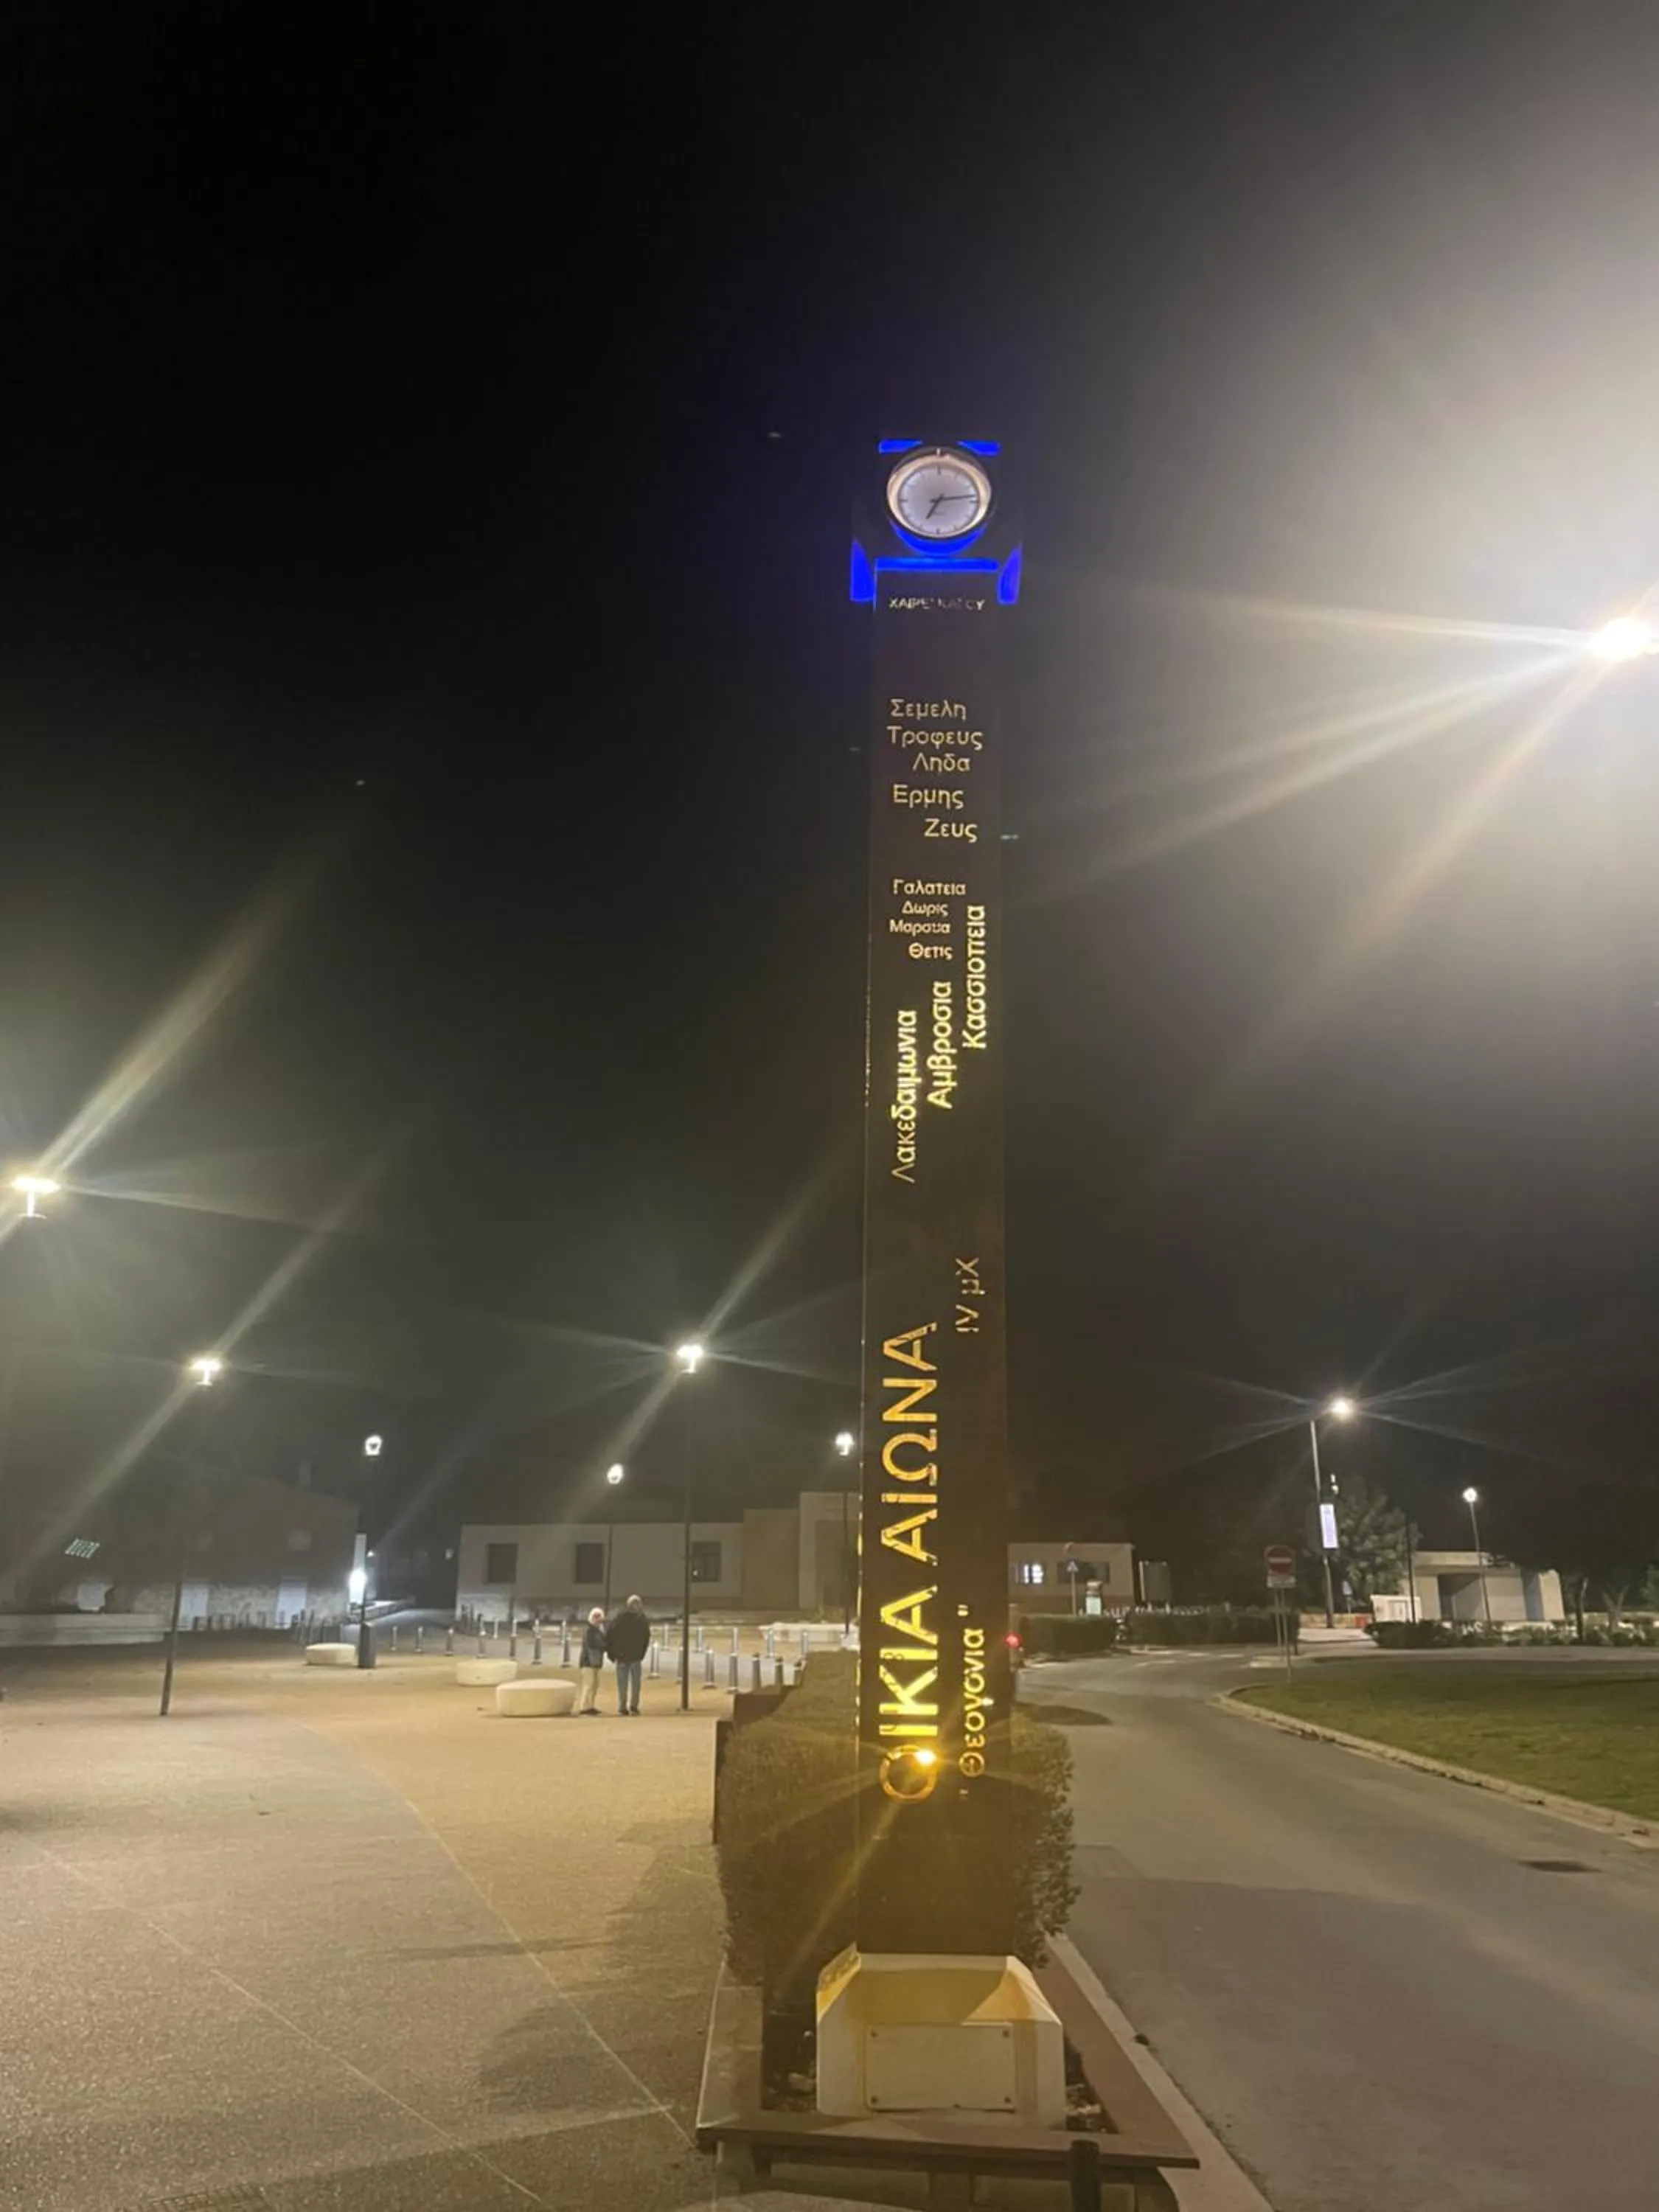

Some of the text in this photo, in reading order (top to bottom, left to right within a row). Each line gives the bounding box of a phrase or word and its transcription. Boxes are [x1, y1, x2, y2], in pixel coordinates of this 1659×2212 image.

[890, 698, 967, 720] Σεμελη
[886, 726, 983, 751] Τροφευς
[912, 752, 970, 773] Ληδα
[893, 784, 964, 810] Ερμης
[925, 818, 978, 843] Ζευς
[893, 878, 967, 896] Γαλατεια
[902, 900, 949, 917] Δωρις
[908, 942, 953, 961] Θετις
[961, 905, 987, 1049] Κασσιοπεια
[927, 981, 957, 1109] Αμβροσια
[891, 1009, 922, 1183] Λακεδαιμωνια
[879, 1321, 939, 1804] ΟΙΚΙΑ ΑΙΩΝΑ
